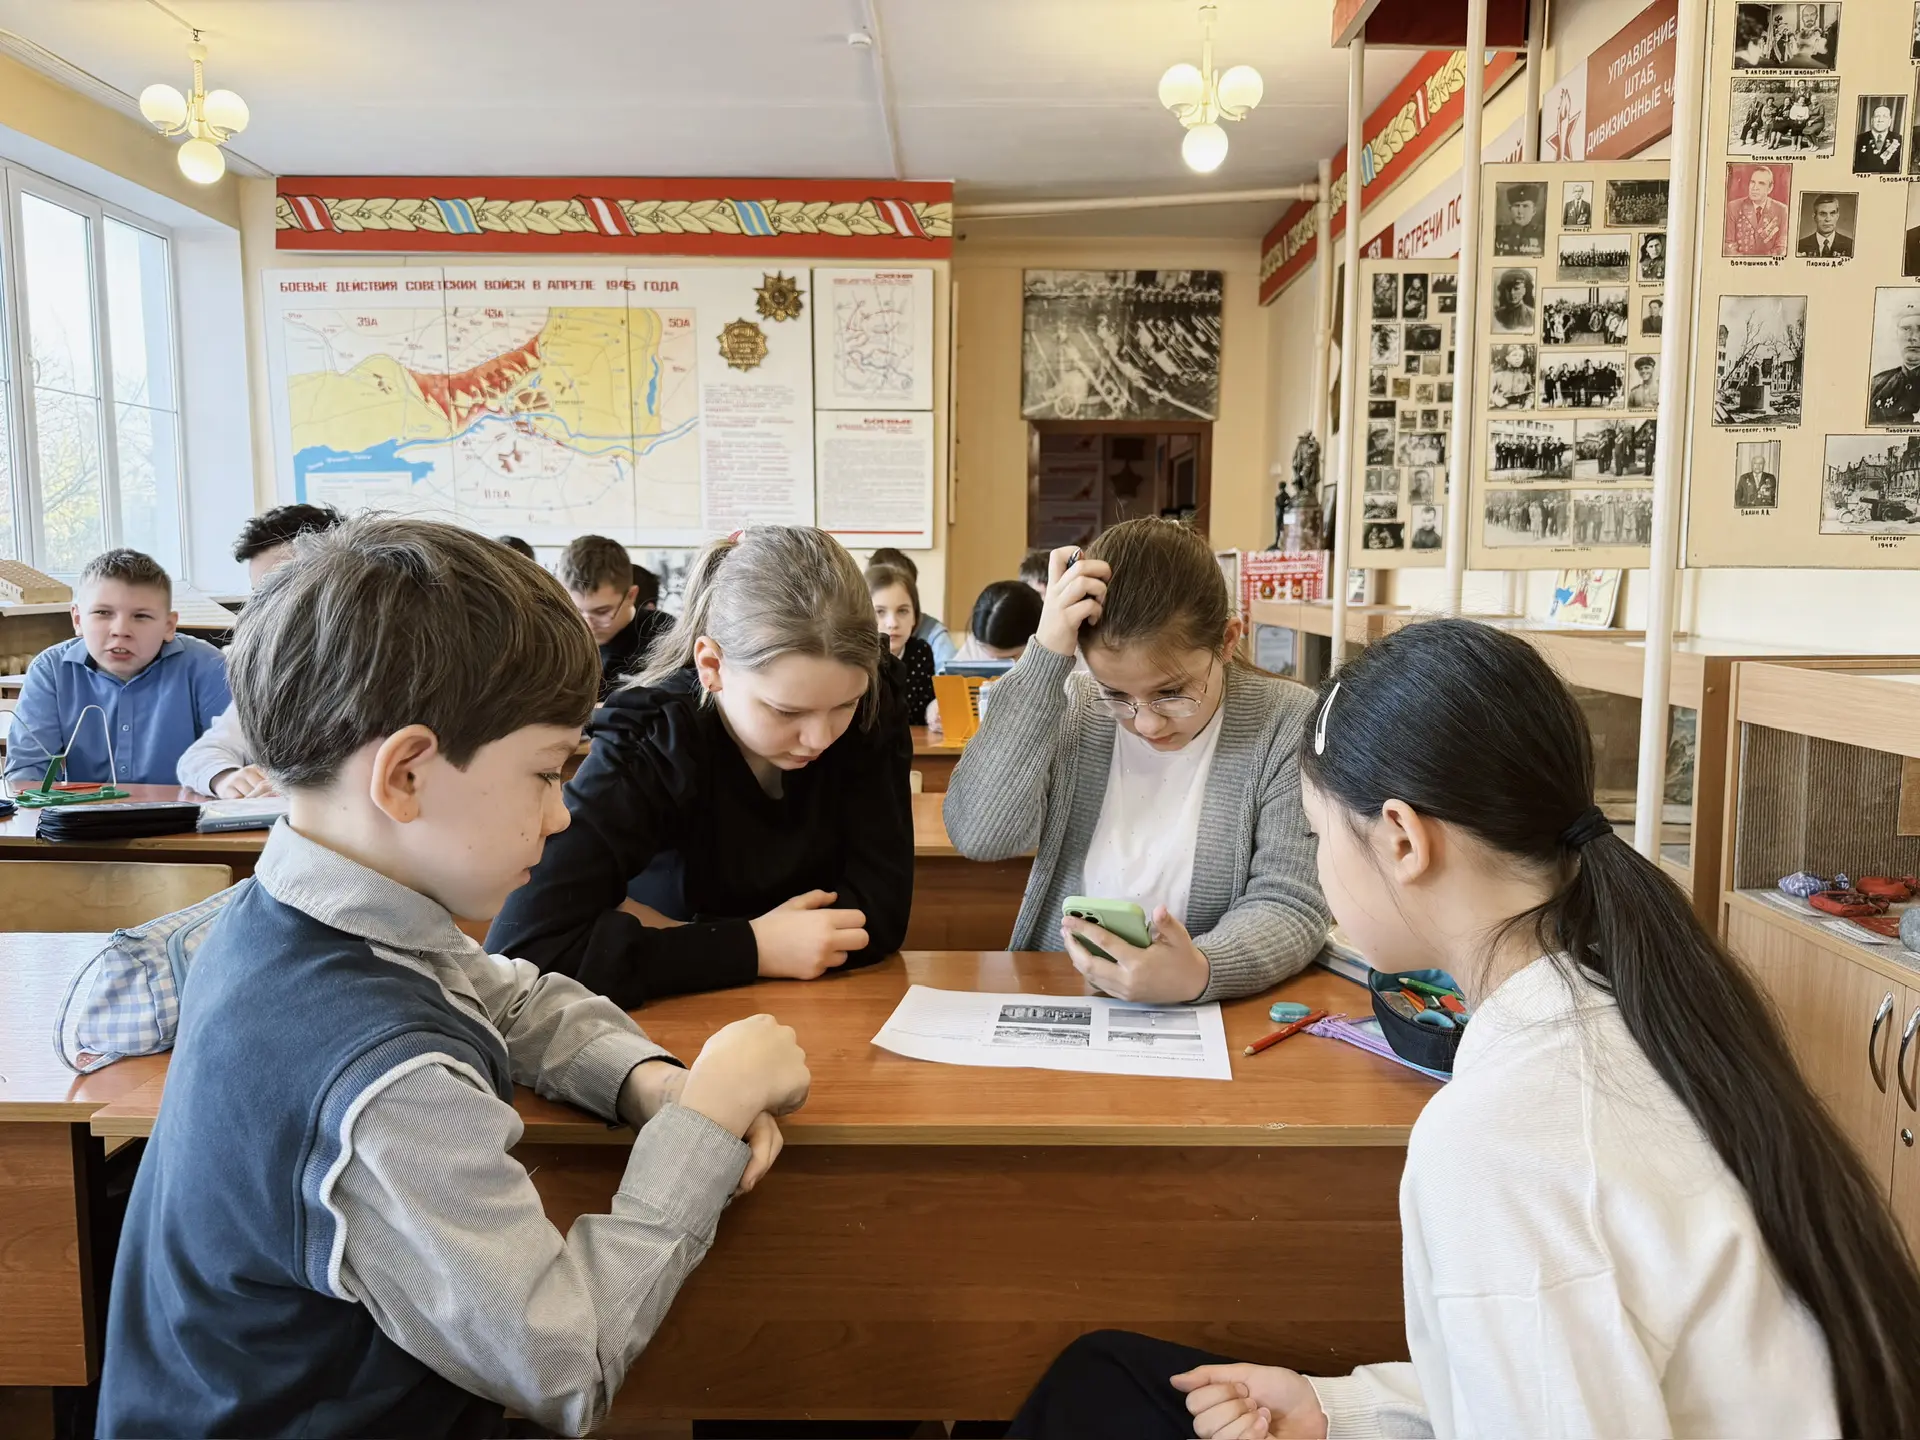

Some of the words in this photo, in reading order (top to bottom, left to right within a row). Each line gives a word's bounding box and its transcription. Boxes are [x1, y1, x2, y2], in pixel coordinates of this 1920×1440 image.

[1624, 61, 1656, 99] ШТАБ,
[1586, 84, 1661, 155] ДИВИЗИОННЫЕ
[1397, 208, 1443, 260] ВСТРЕЧИ
[280, 281, 328, 292] БОЕВЫЕ
[336, 279, 398, 292] ДЕЙСТВИЯ
[405, 280, 477, 291] СОВЕТСКИХ
[485, 279, 525, 290] ВОЙСК
[532, 280, 541, 290] В
[547, 280, 596, 290] АПРЕЛЕ
[606, 280, 636, 291] 1945
[644, 281, 679, 292] ГОДА
